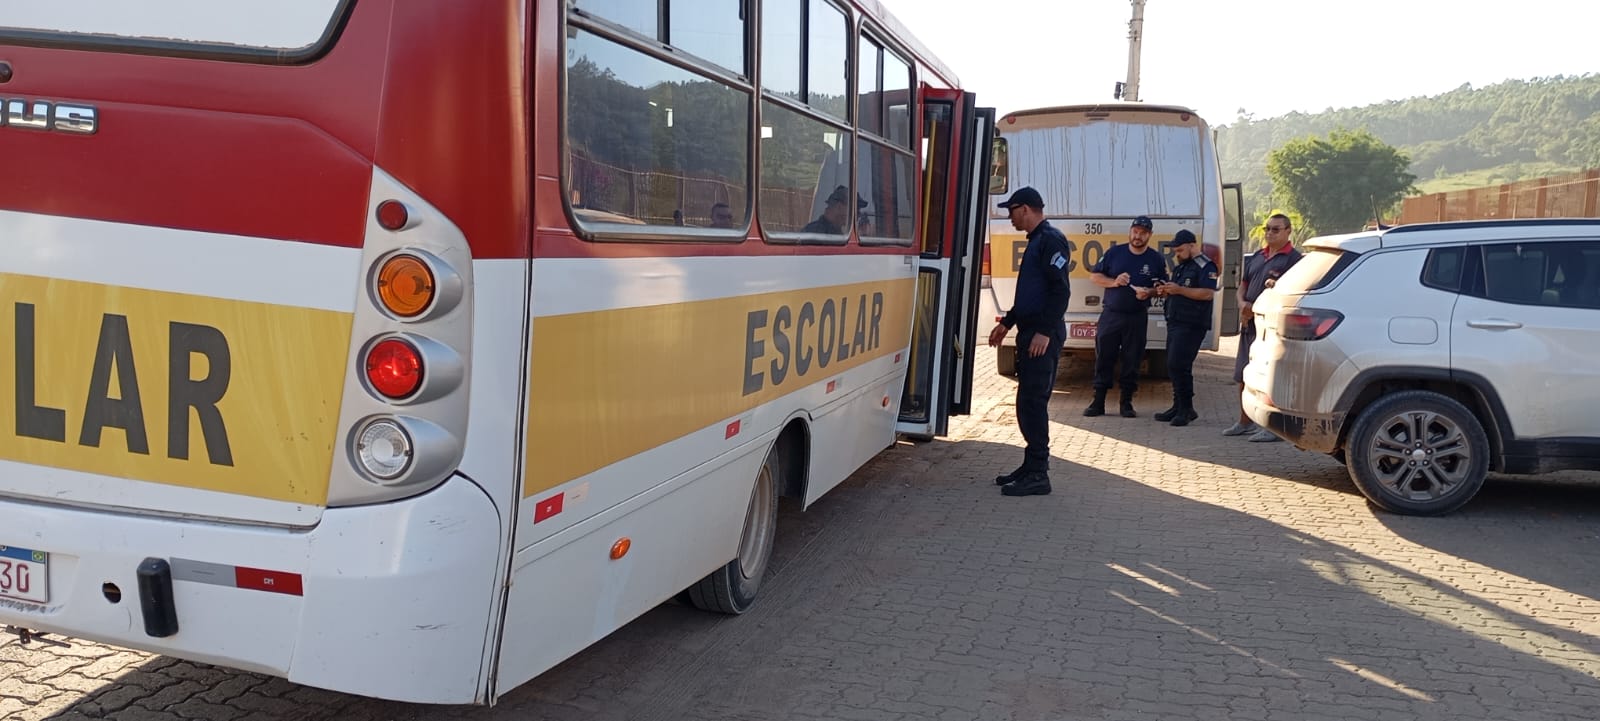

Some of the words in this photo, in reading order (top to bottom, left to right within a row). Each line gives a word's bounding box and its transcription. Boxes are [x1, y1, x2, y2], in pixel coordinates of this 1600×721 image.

[0, 98, 98, 135] US
[1084, 223, 1103, 235] 350
[743, 291, 883, 397] ESCOLAR
[15, 301, 235, 468] LAR
[0, 561, 30, 593] 30
